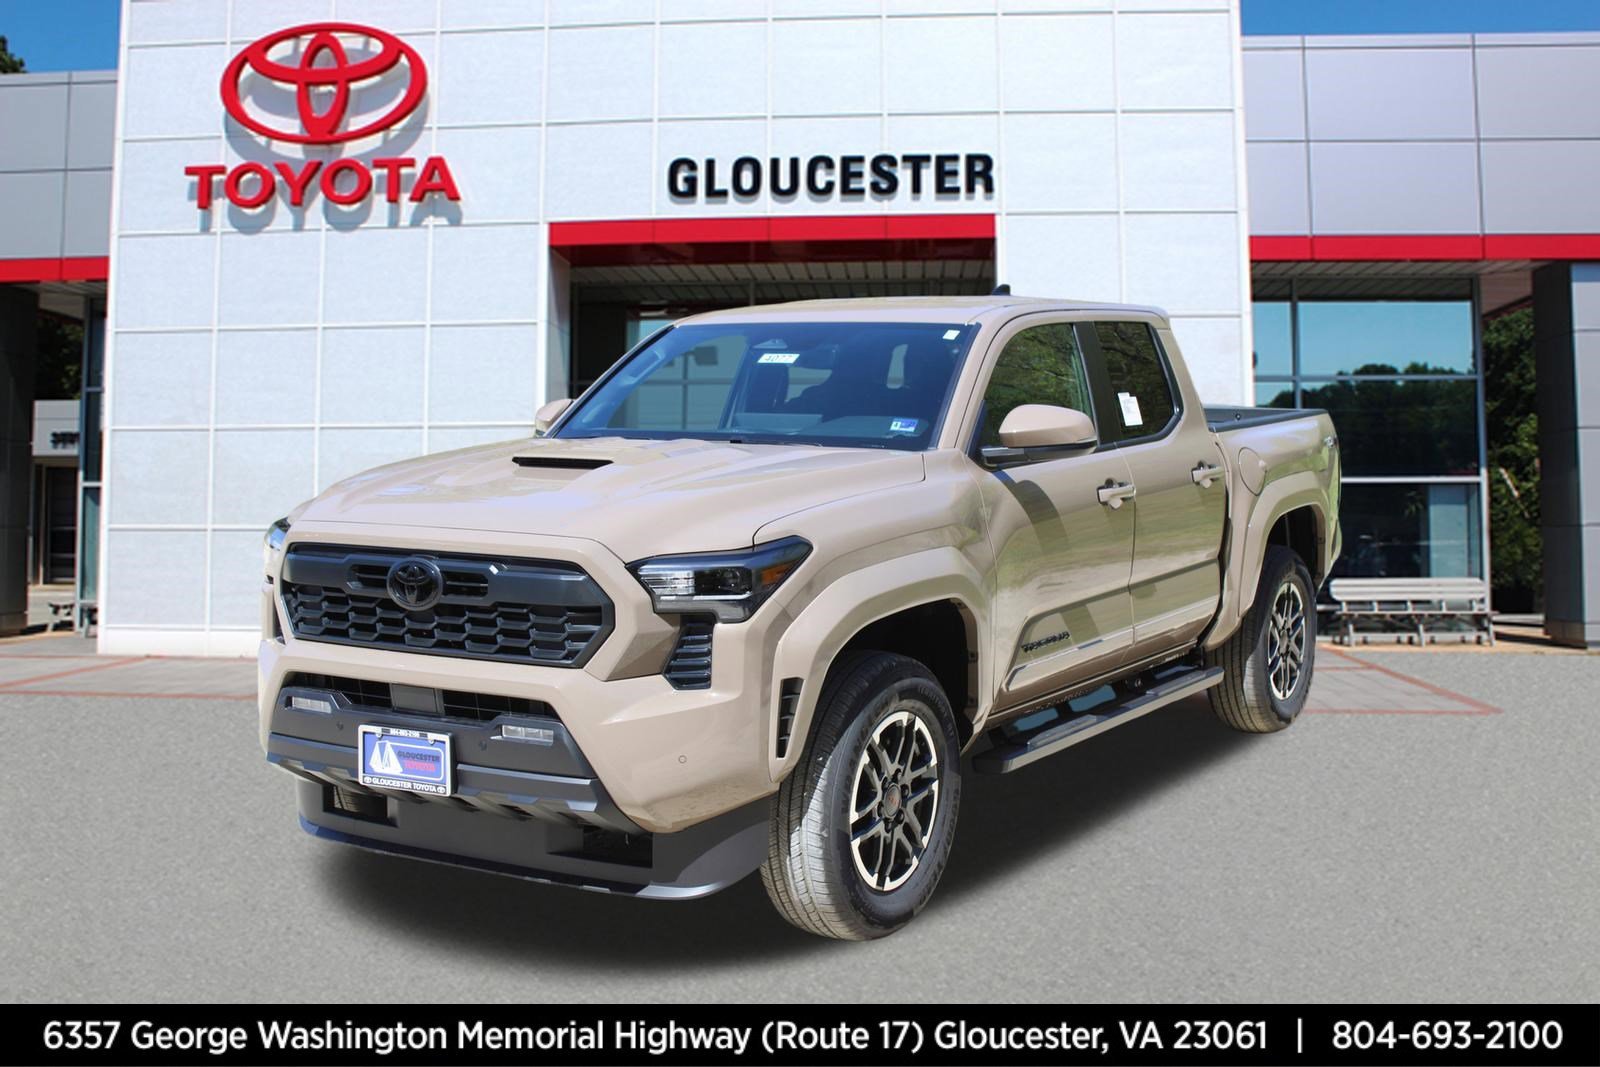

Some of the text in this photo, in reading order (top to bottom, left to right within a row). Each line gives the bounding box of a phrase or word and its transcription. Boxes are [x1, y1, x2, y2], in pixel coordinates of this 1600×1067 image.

[184, 156, 461, 209] TOYOTA
[667, 153, 996, 198] GLOUCESTER
[397, 750, 440, 762] GLOUCESTER
[372, 777, 437, 793] GLOUCESTER TOYOTA
